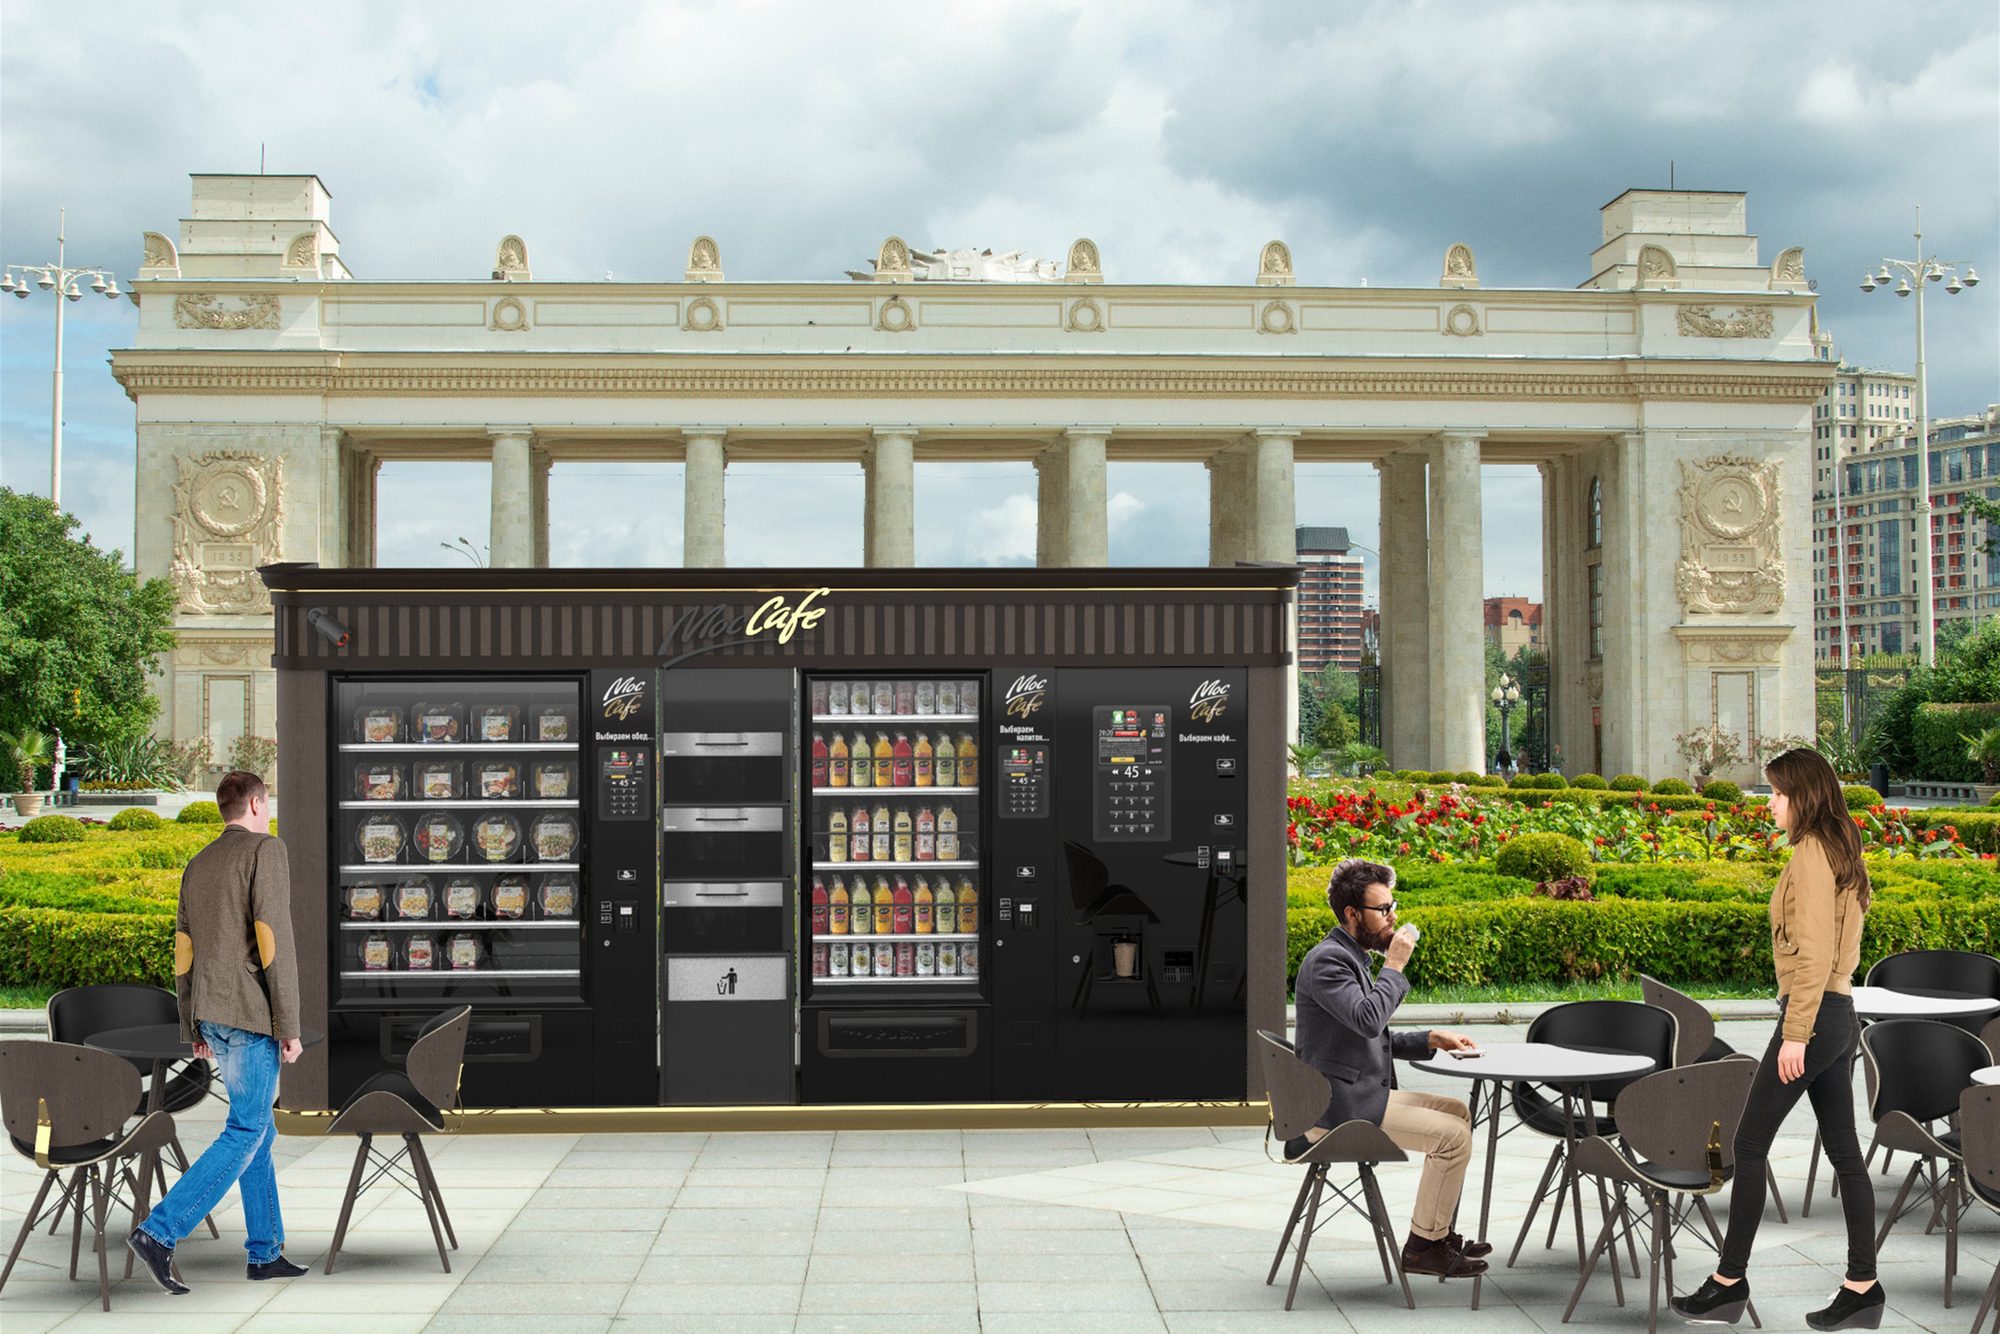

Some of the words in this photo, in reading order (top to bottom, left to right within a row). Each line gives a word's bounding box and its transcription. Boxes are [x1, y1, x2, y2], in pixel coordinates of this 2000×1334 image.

[745, 587, 830, 644] Cafe
[999, 725, 1034, 735] Выбираем
[595, 732, 630, 742] Выбираем
[1179, 733, 1212, 743] Выбираем
[1124, 765, 1139, 778] 45
[619, 779, 629, 787] 45
[1018, 777, 1029, 785] 45
